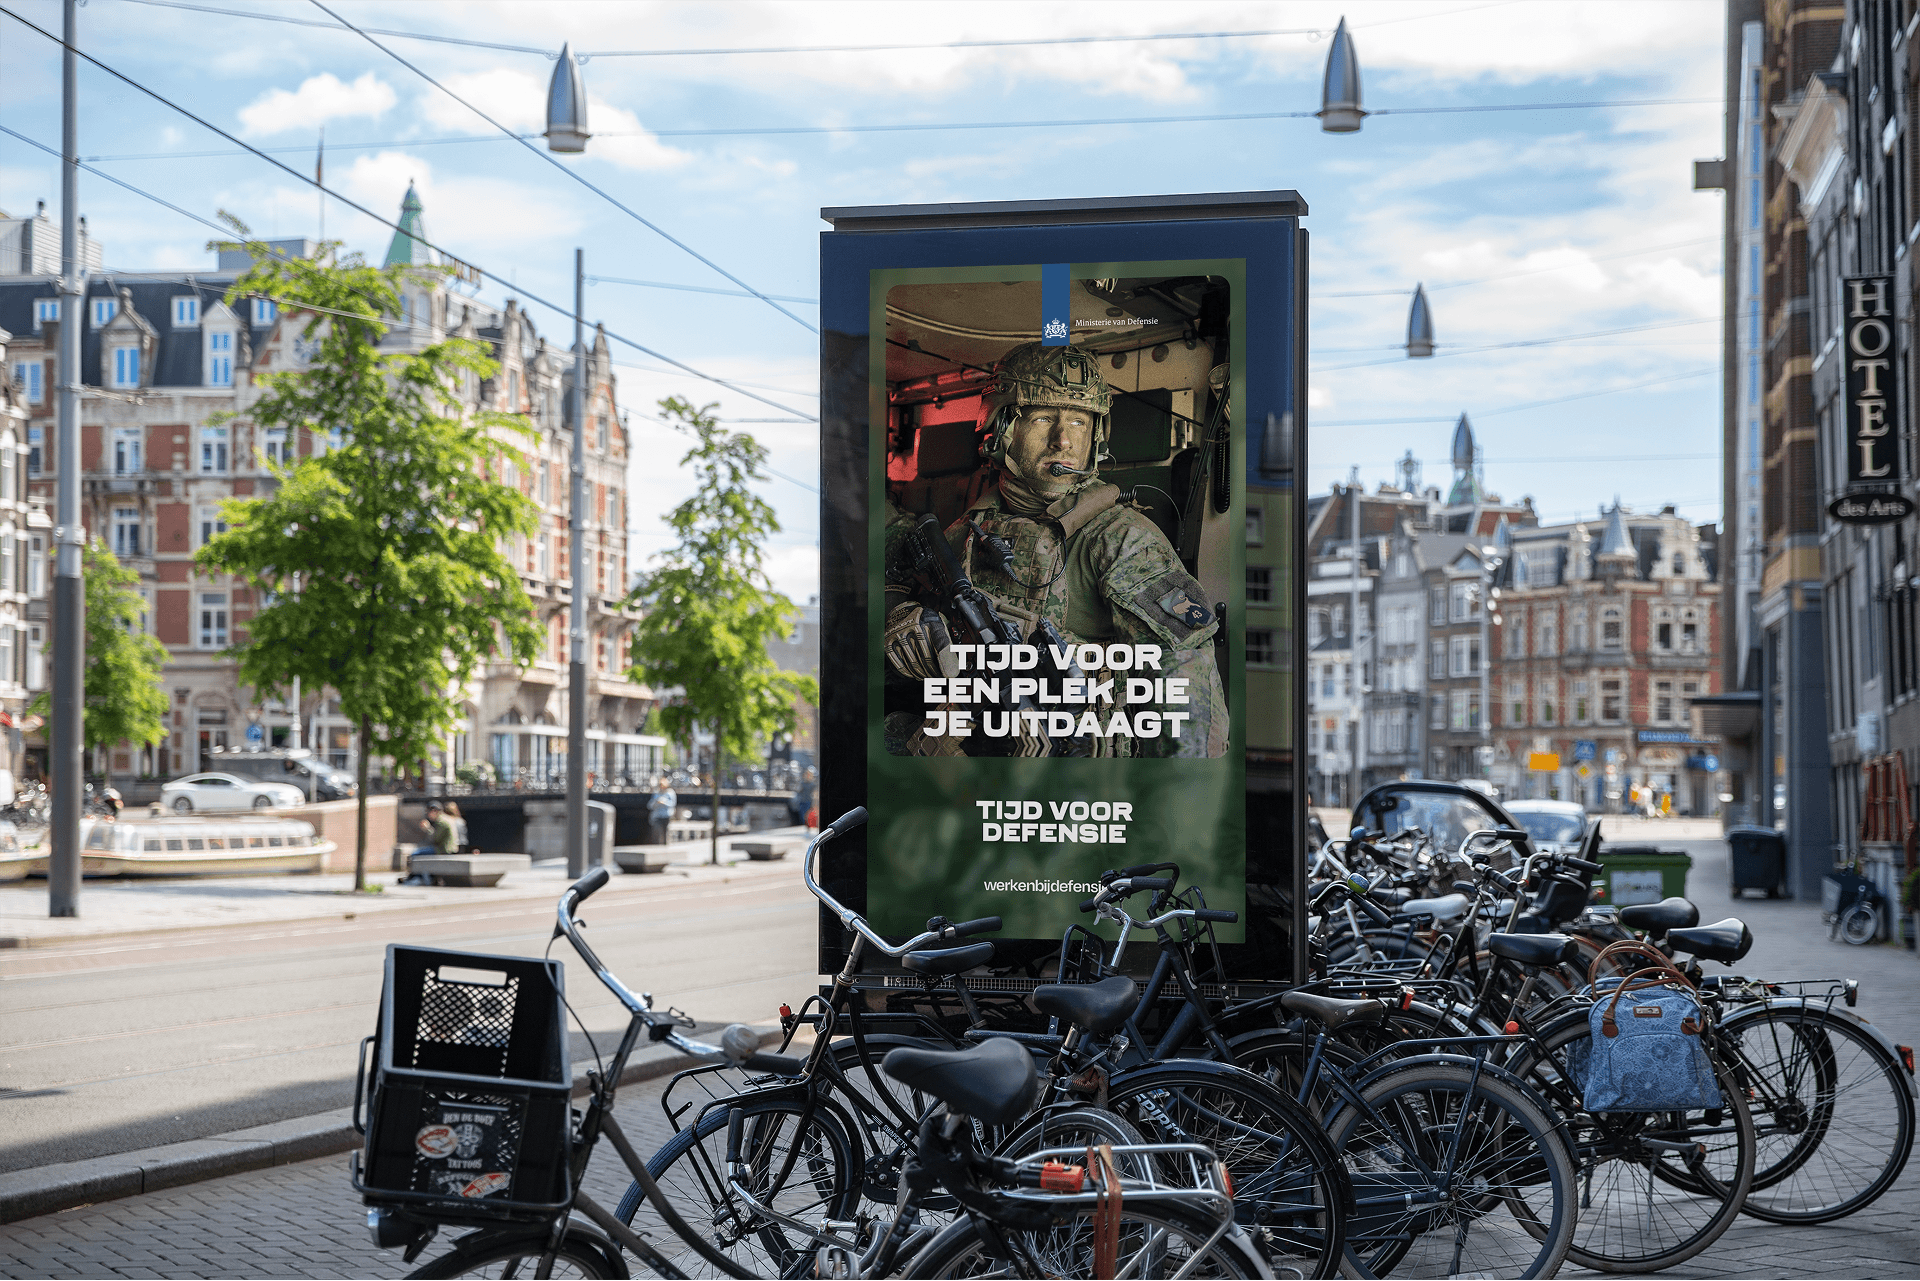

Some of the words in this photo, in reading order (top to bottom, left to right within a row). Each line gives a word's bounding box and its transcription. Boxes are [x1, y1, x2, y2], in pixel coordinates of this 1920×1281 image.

[1075, 318, 1111, 327] Ministerie
[1127, 317, 1159, 325] Defensie
[1846, 278, 1892, 478] HOTEL
[1836, 498, 1867, 517] des
[1867, 498, 1907, 517] Arts
[949, 644, 1039, 671] TIJD
[1045, 643, 1162, 671] VOOR
[923, 677, 1000, 704] EEN
[1011, 677, 1115, 705] PLEK
[1126, 678, 1190, 705] DIE
[923, 711, 972, 737] JE
[982, 711, 1190, 738] UITDAAGT
[976, 800, 1043, 821] TIJD
[1049, 801, 1133, 822] VOOR
[982, 823, 1127, 844] DEFENSIE
[1132, 1092, 1187, 1138] SPIRIT
